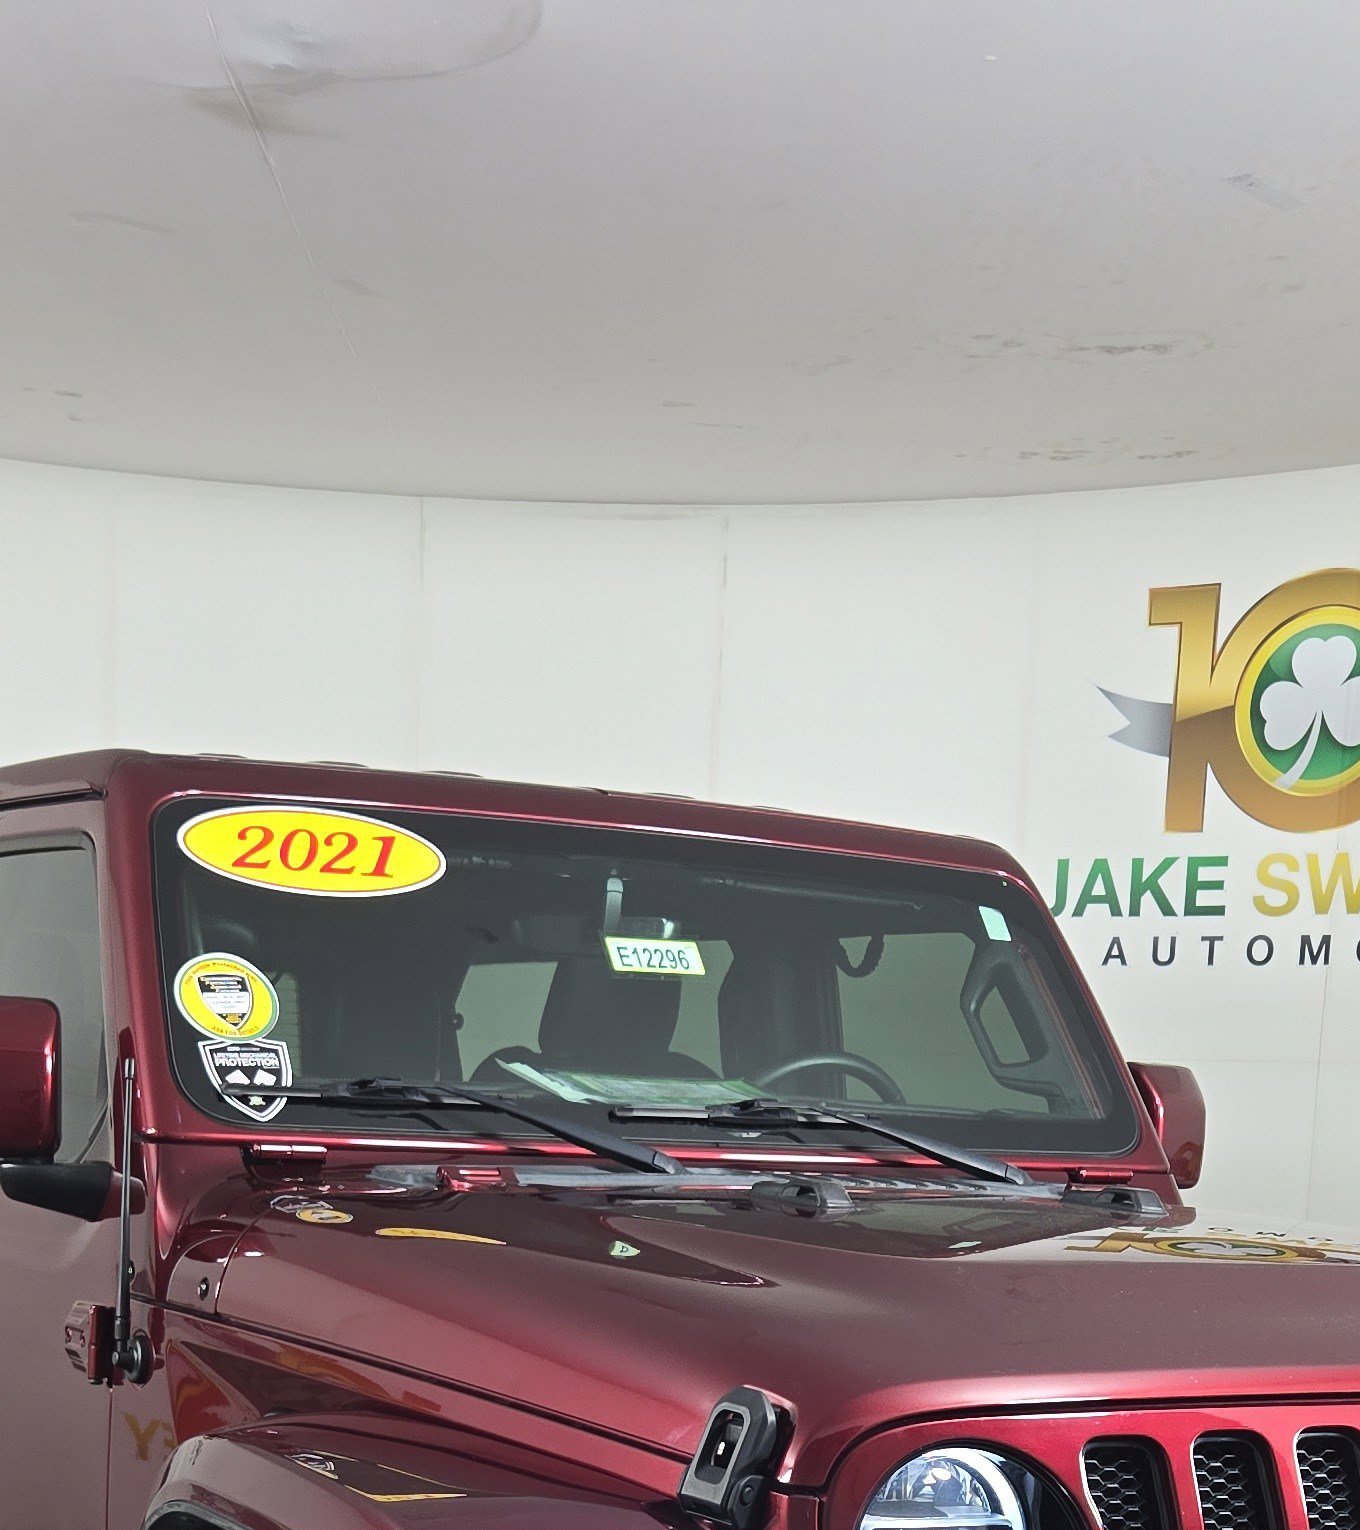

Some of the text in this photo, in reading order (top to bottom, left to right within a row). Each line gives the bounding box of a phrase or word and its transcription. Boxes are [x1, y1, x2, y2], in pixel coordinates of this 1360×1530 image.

[231, 825, 396, 878] 2021
[1049, 855, 1229, 917] JAKE
[616, 946, 690, 970] E12296
[215, 1058, 279, 1067] PROTECTION
